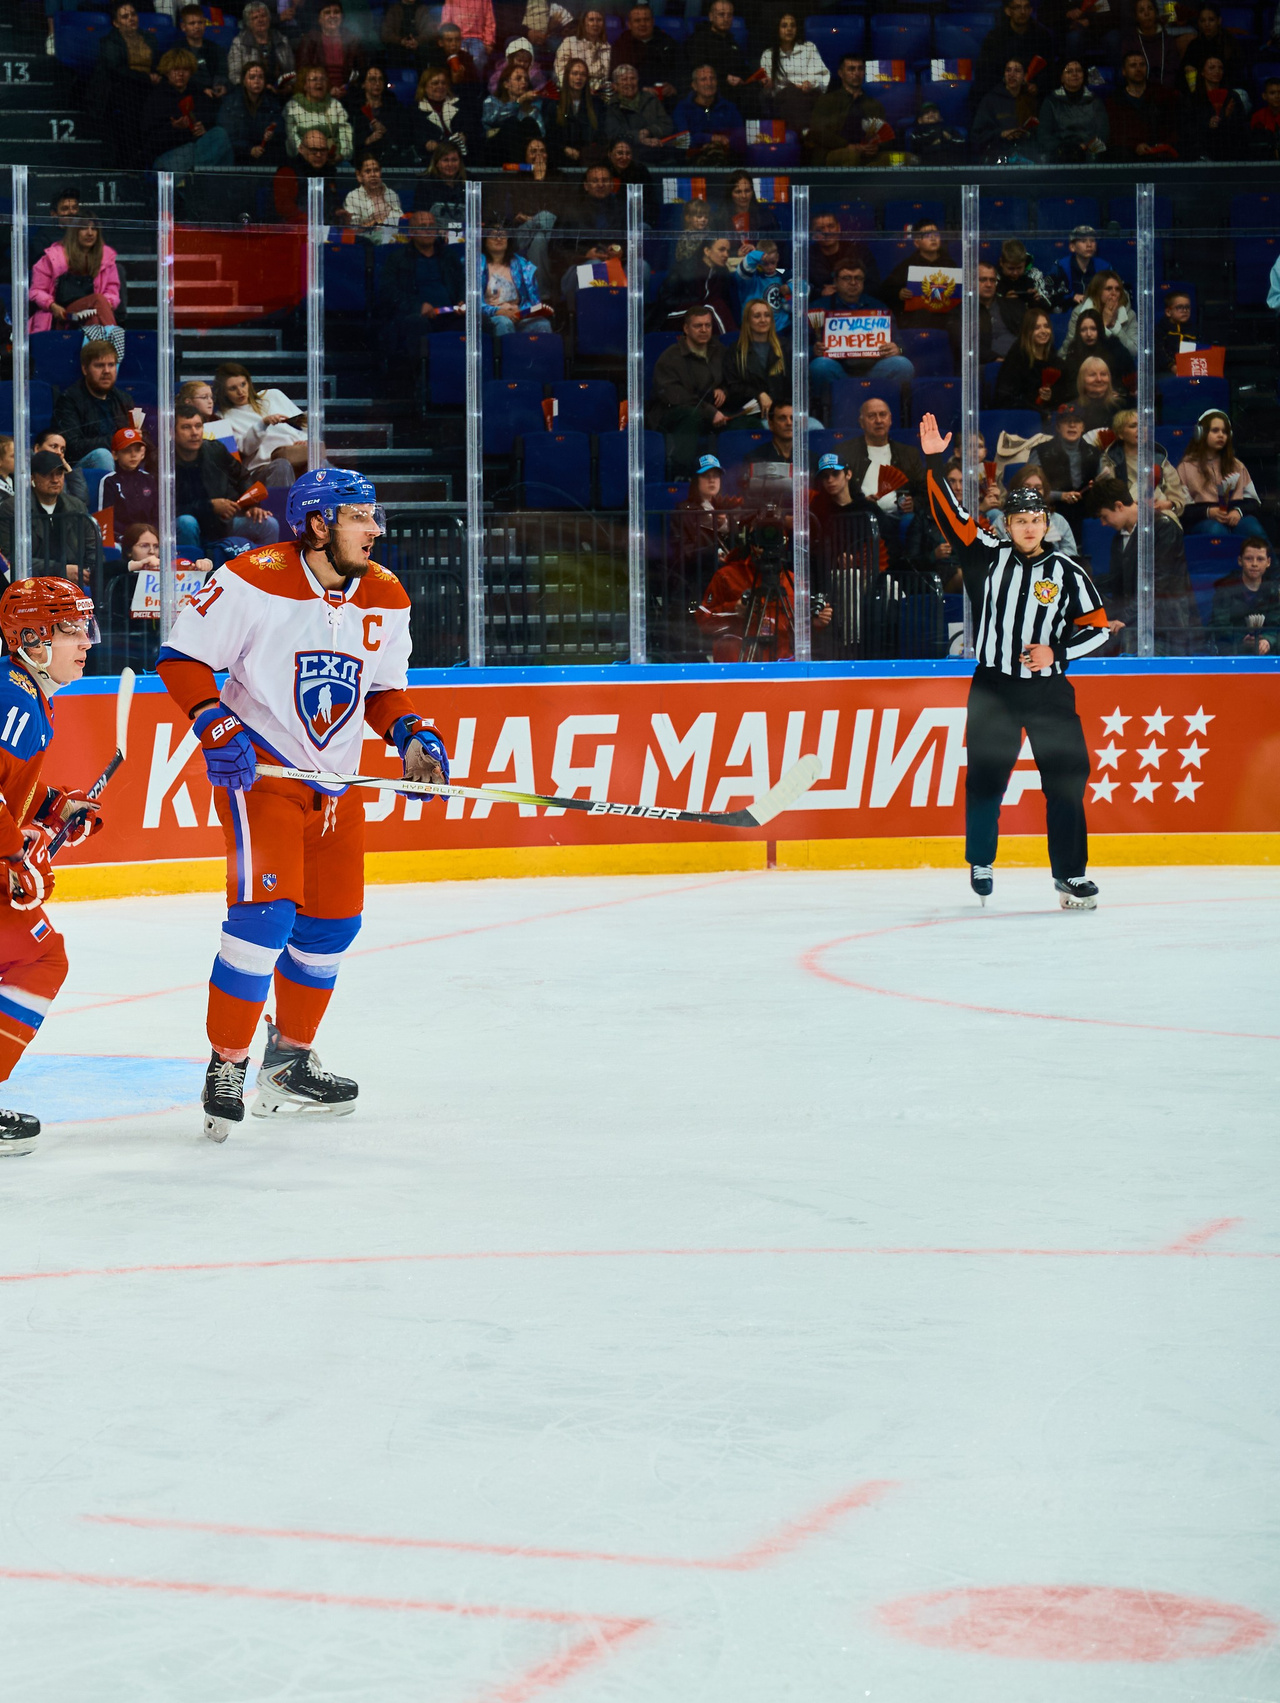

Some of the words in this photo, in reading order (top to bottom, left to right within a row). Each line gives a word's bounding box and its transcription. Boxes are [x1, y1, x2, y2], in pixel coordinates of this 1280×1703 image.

[3, 62, 30, 83] 13
[49, 119, 75, 142] 12
[301, 498, 321, 506] CCM
[190, 578, 224, 618] 21
[362, 614, 383, 652] C
[300, 655, 359, 685] СХЛ
[0, 705, 31, 748] 11
[211, 715, 241, 742] BAU
[588, 802, 682, 821] BAUER
